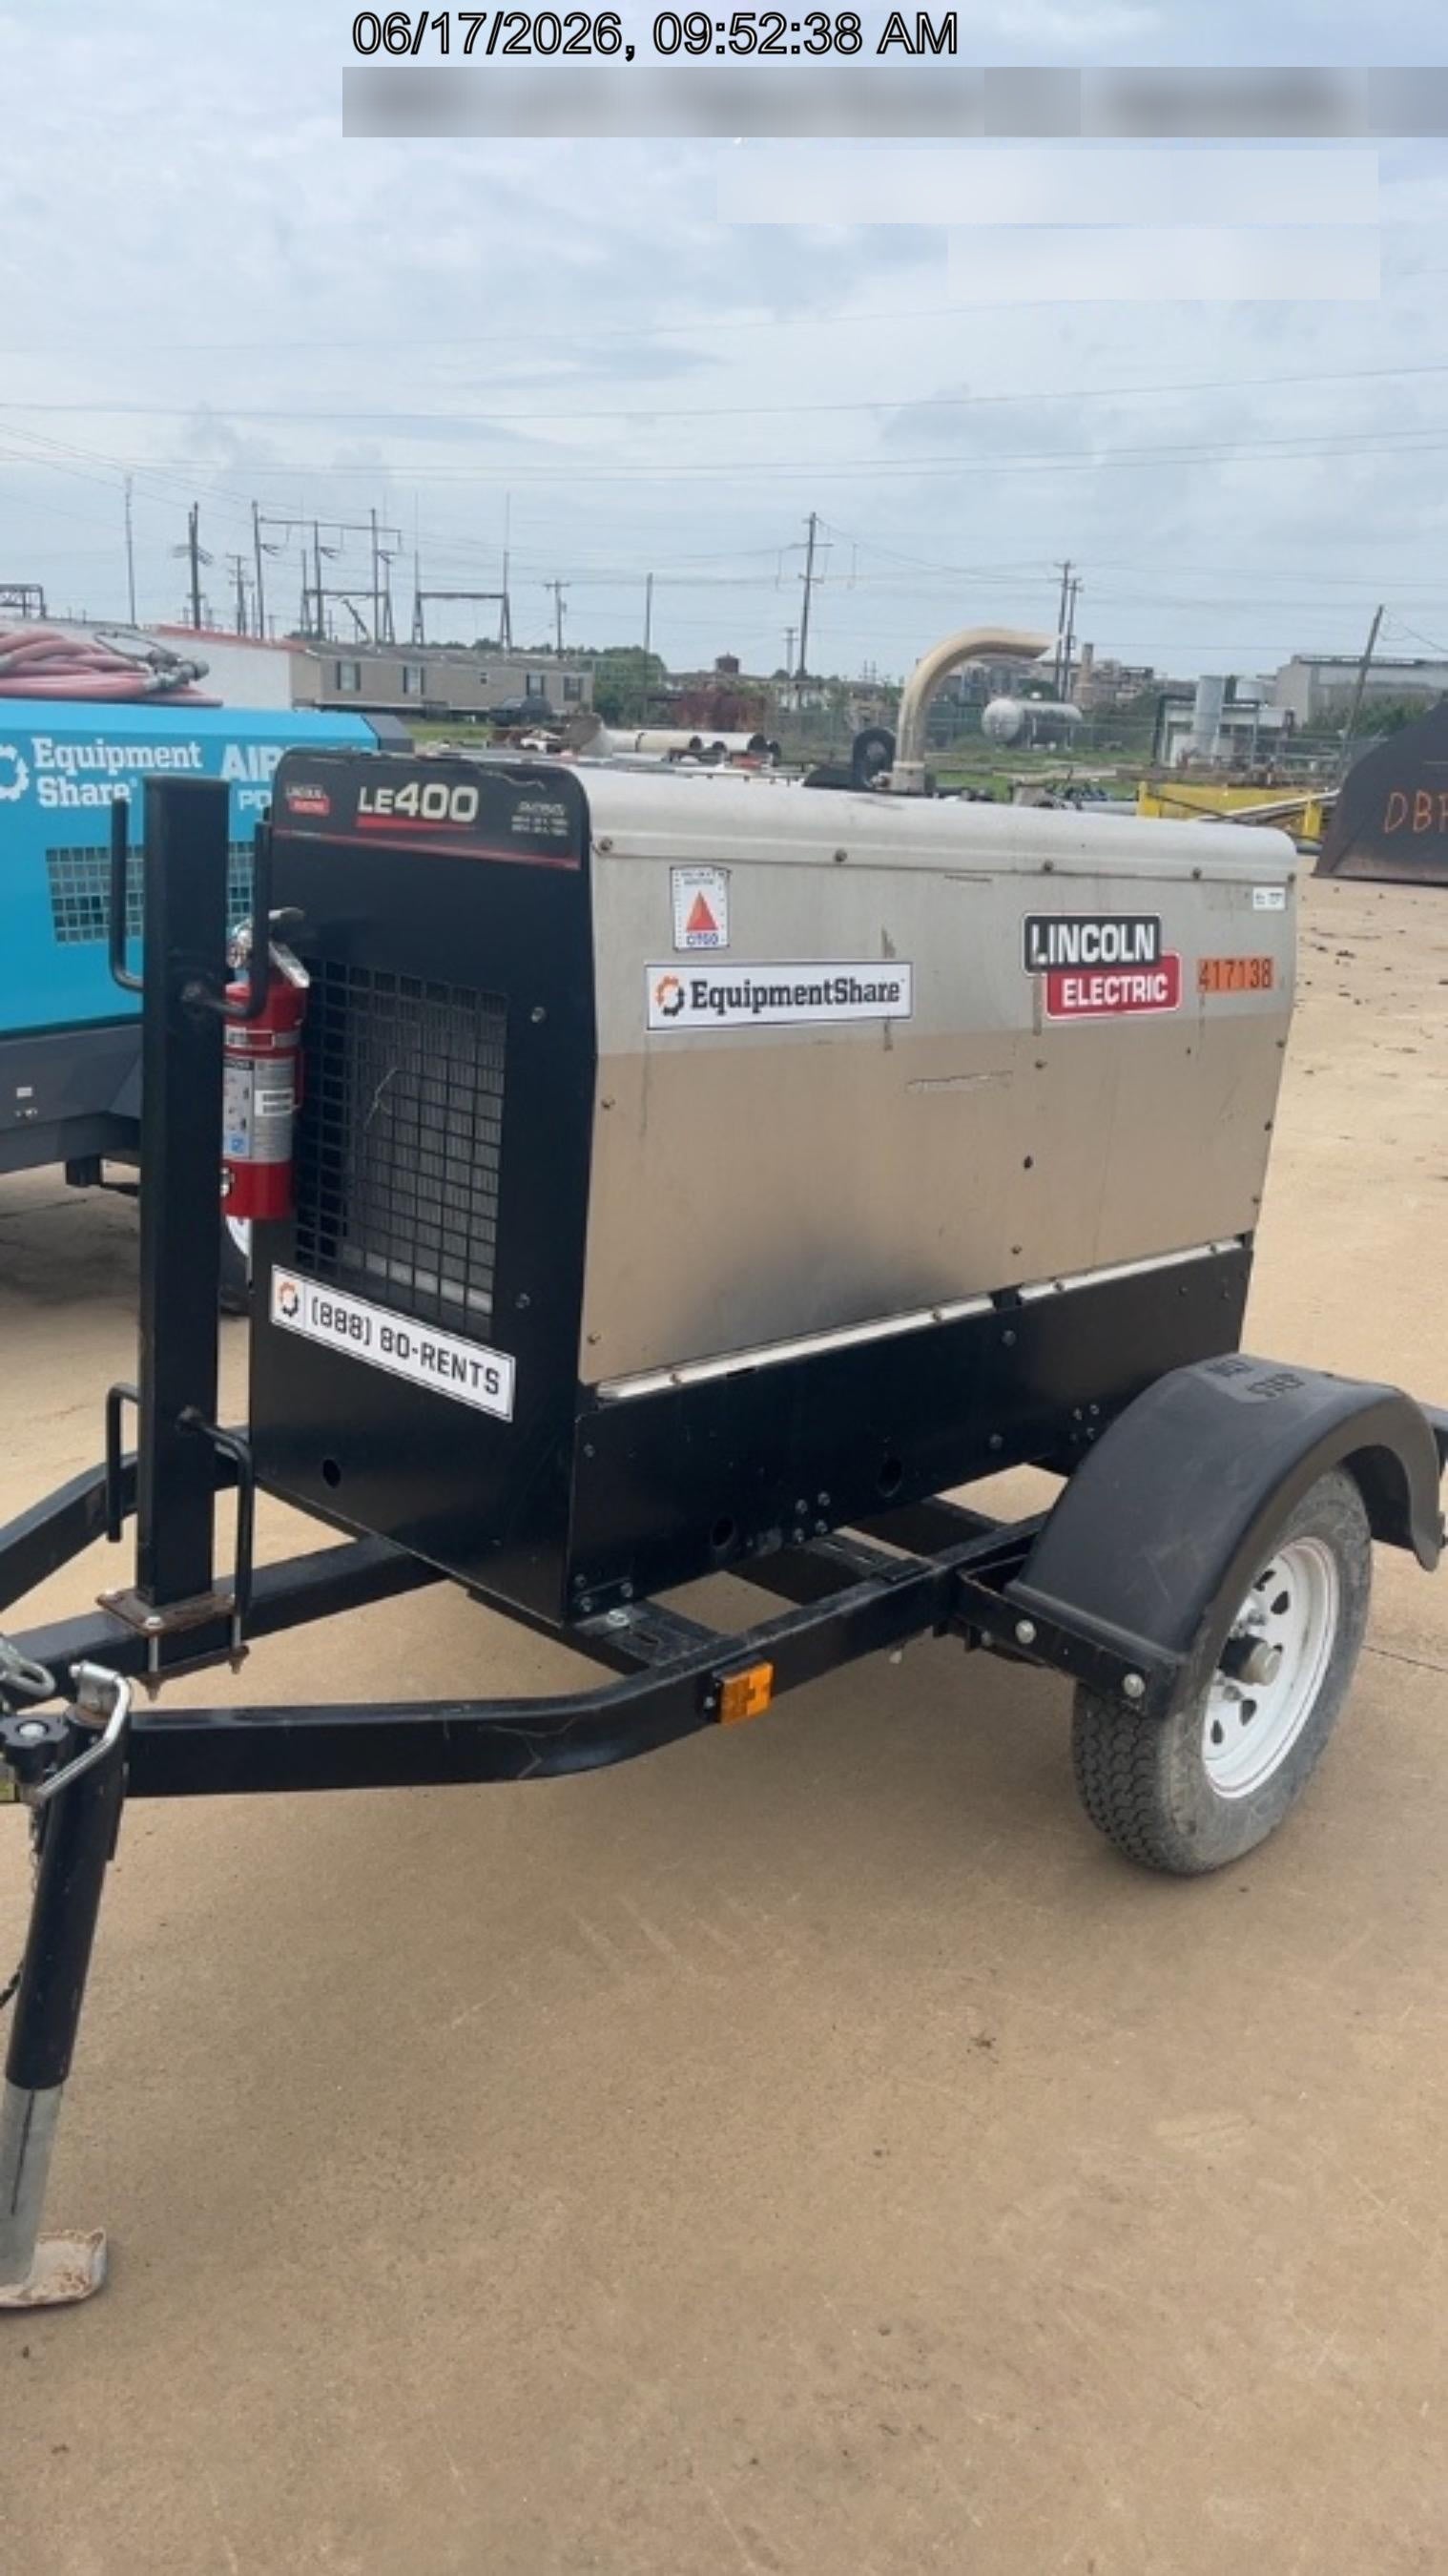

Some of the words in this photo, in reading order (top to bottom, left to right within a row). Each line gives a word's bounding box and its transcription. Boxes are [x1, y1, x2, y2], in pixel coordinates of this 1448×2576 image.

[31, 737, 203, 776] Equipment
[358, 781, 479, 822] LE400
[1030, 923, 1155, 964] LINCOLN
[1061, 973, 1169, 1008] ELECTRIC
[1198, 957, 1273, 990] 417138
[690, 977, 900, 1013] EquipmentShare
[312, 1297, 372, 1346] (888)
[381, 1327, 499, 1395] 80-RENTS
